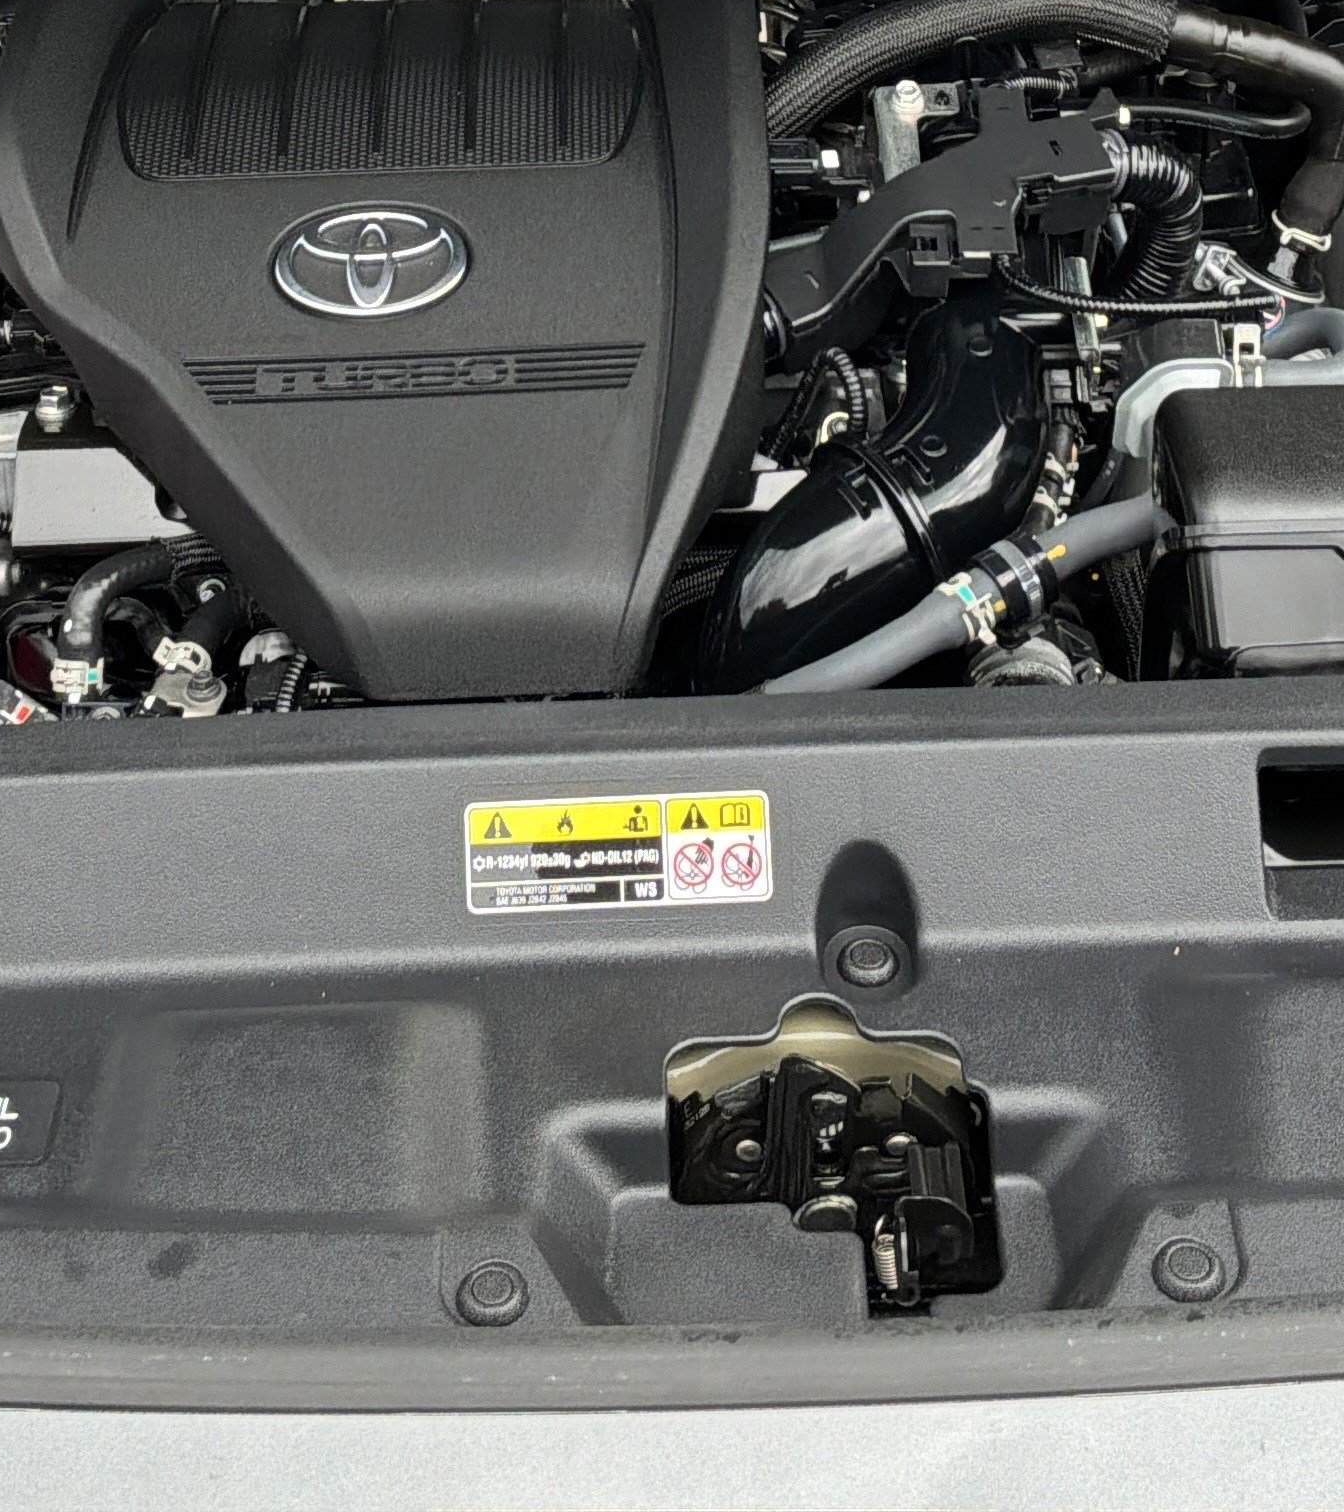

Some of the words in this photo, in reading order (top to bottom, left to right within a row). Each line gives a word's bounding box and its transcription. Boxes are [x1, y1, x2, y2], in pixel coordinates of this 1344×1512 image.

[260, 357, 510, 395] TURBO
[496, 887, 522, 897] TOYOTA
[523, 885, 548, 896] MOTOR
[548, 883, 596, 895] CORPORATION
[634, 881, 658, 898] WS
